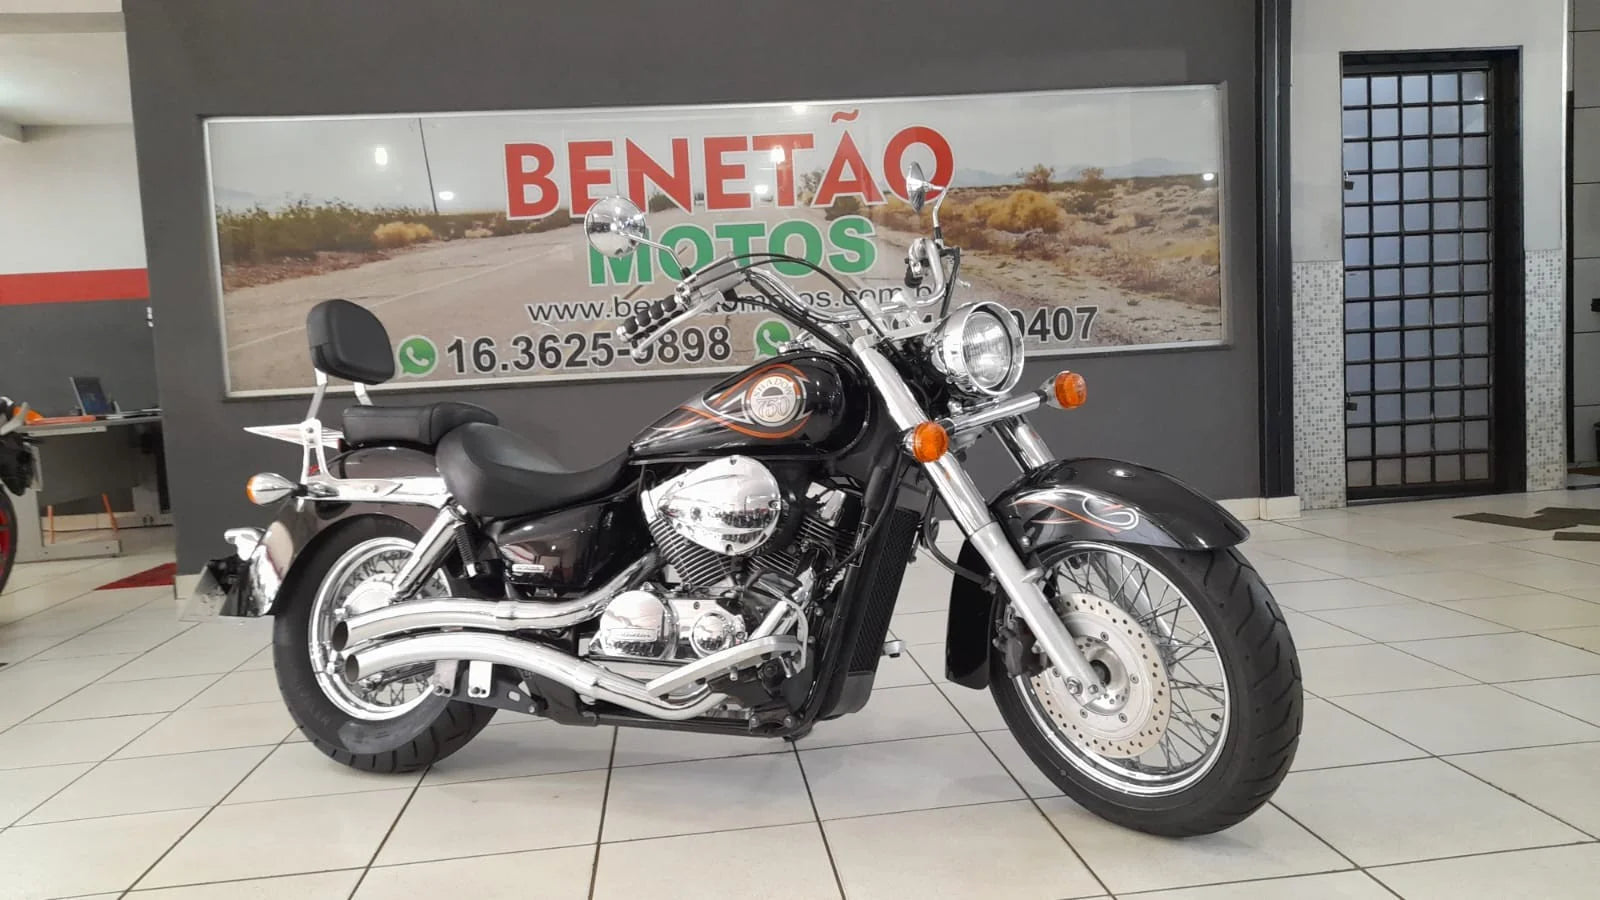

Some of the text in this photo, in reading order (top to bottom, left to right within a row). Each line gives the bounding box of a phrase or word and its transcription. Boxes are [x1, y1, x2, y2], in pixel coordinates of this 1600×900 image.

[504, 108, 954, 219] BENETÃO
[590, 216, 876, 285] MOTOS
[758, 396, 791, 417] 750
